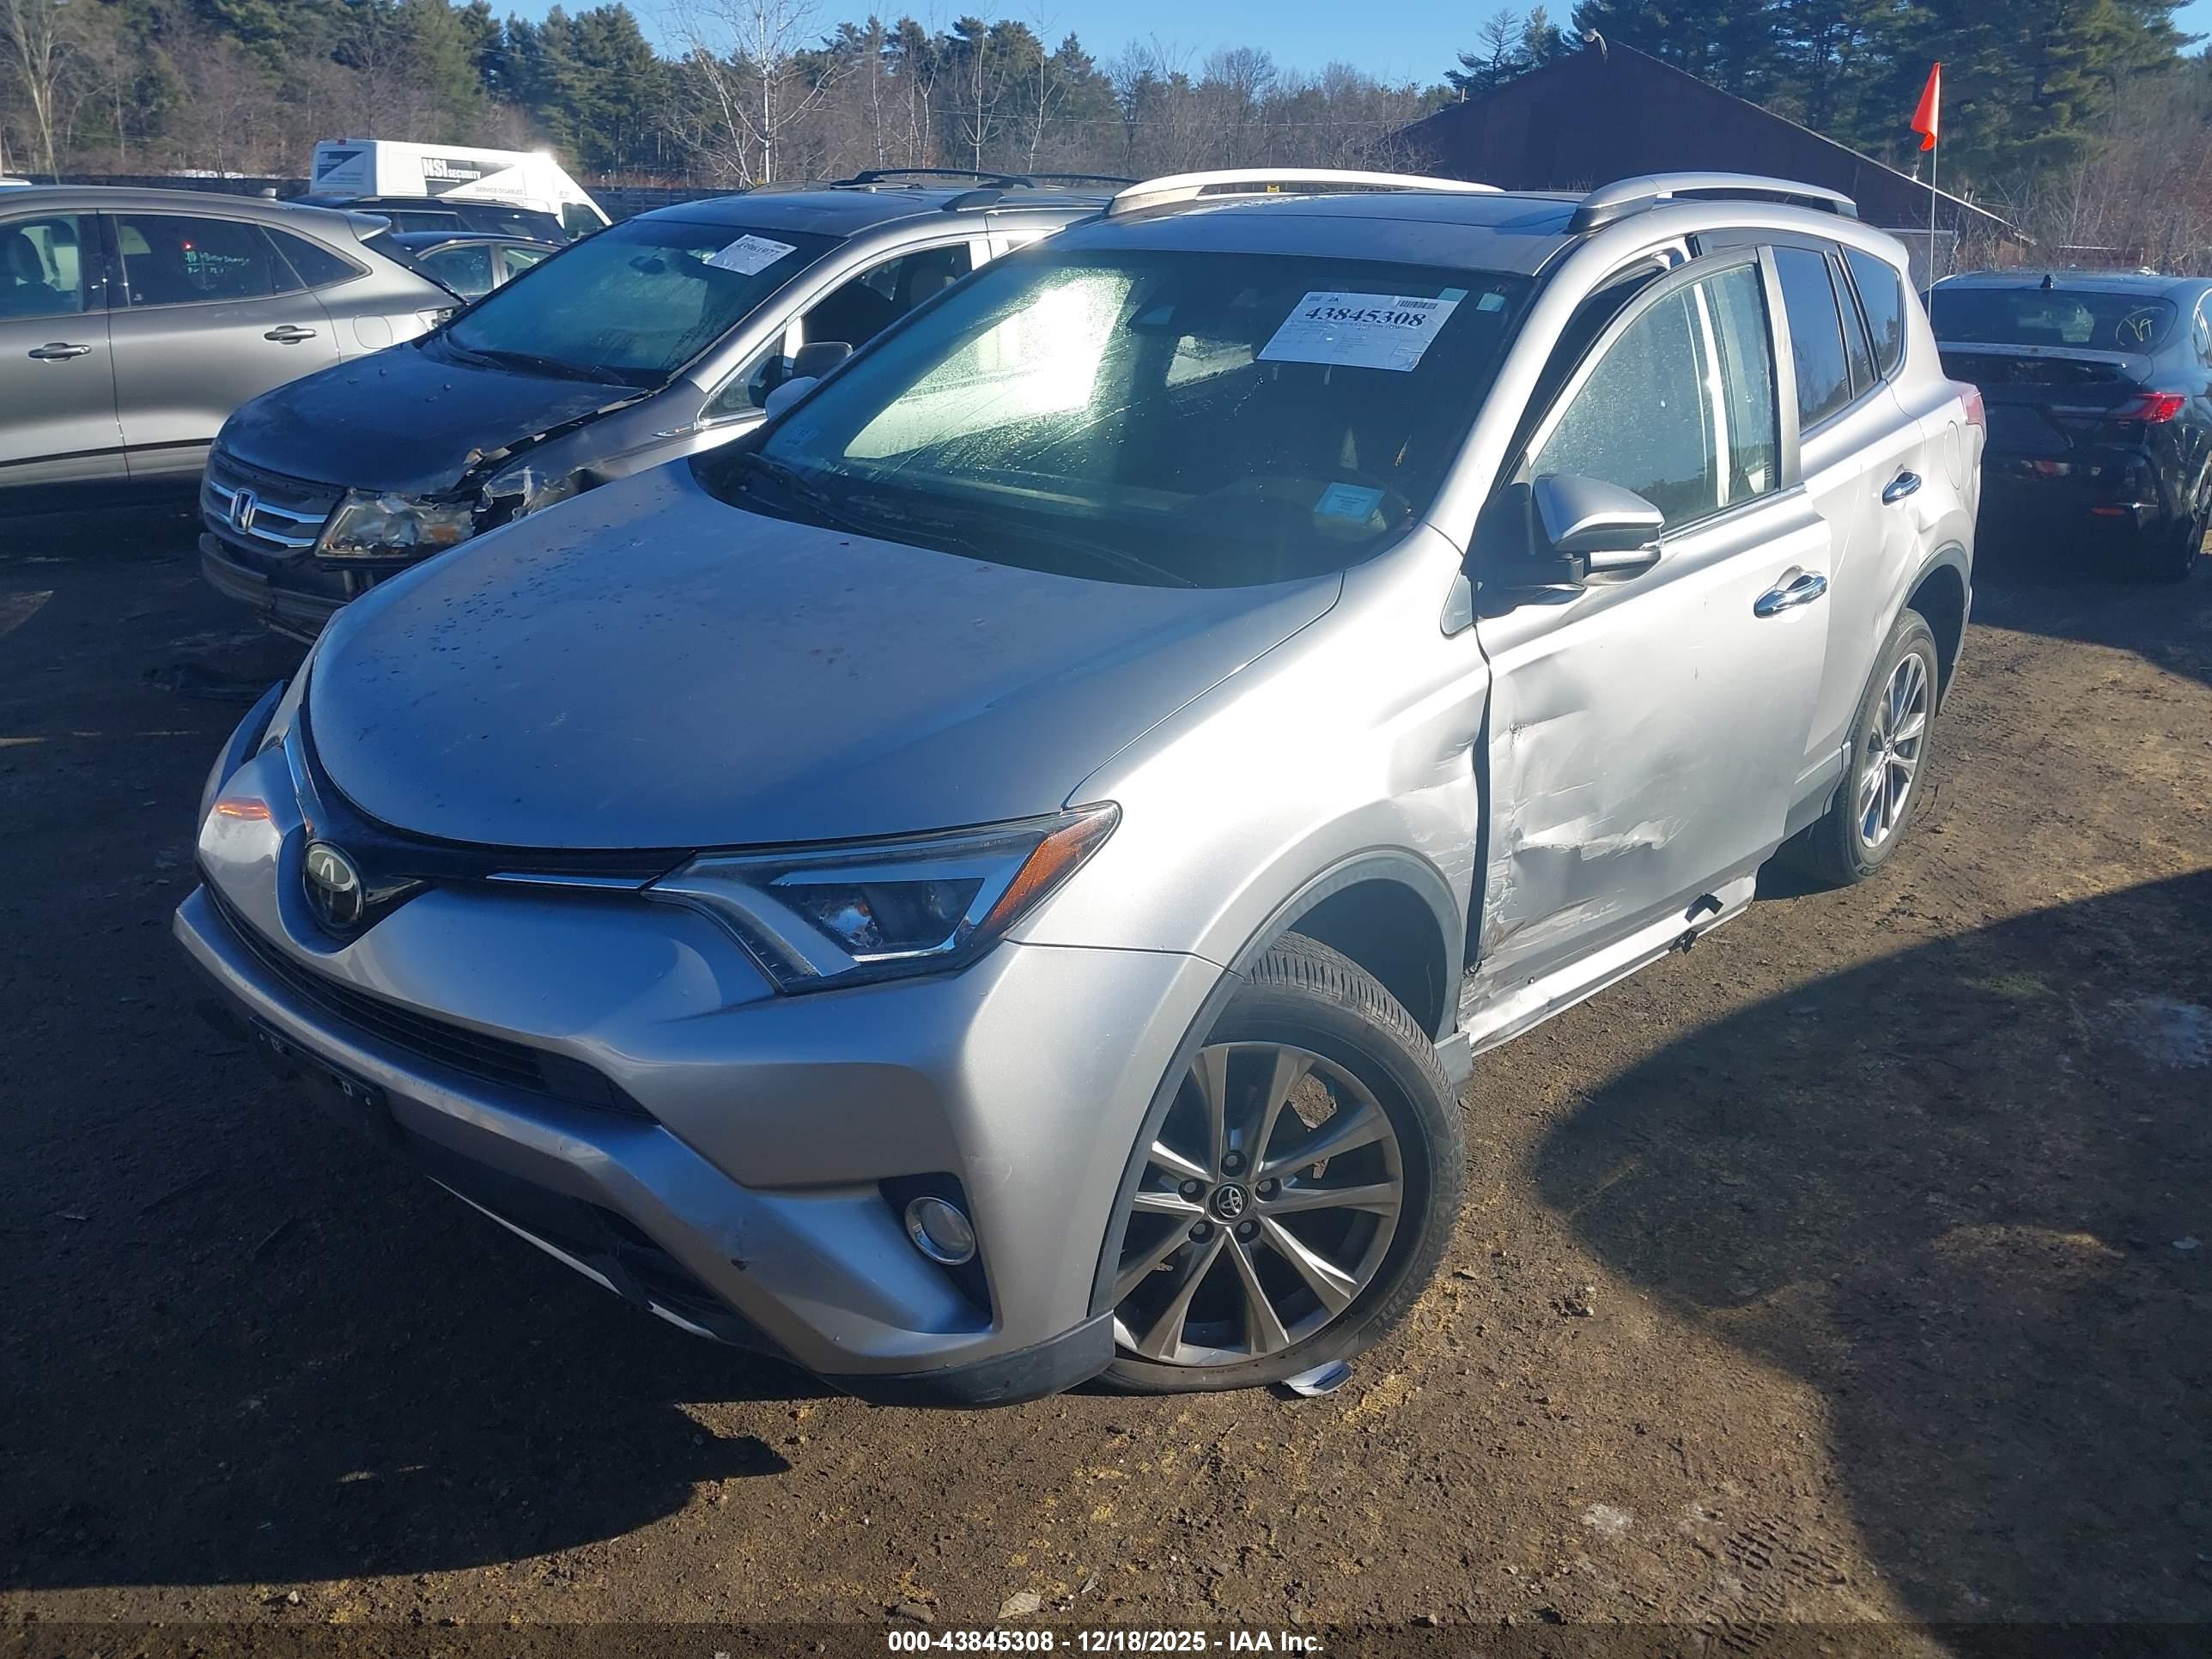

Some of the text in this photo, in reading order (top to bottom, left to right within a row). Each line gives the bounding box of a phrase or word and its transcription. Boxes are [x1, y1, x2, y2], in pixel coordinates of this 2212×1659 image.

[422, 158, 482, 180] NSI SECURITY
[1304, 306, 1426, 328] 43845308
